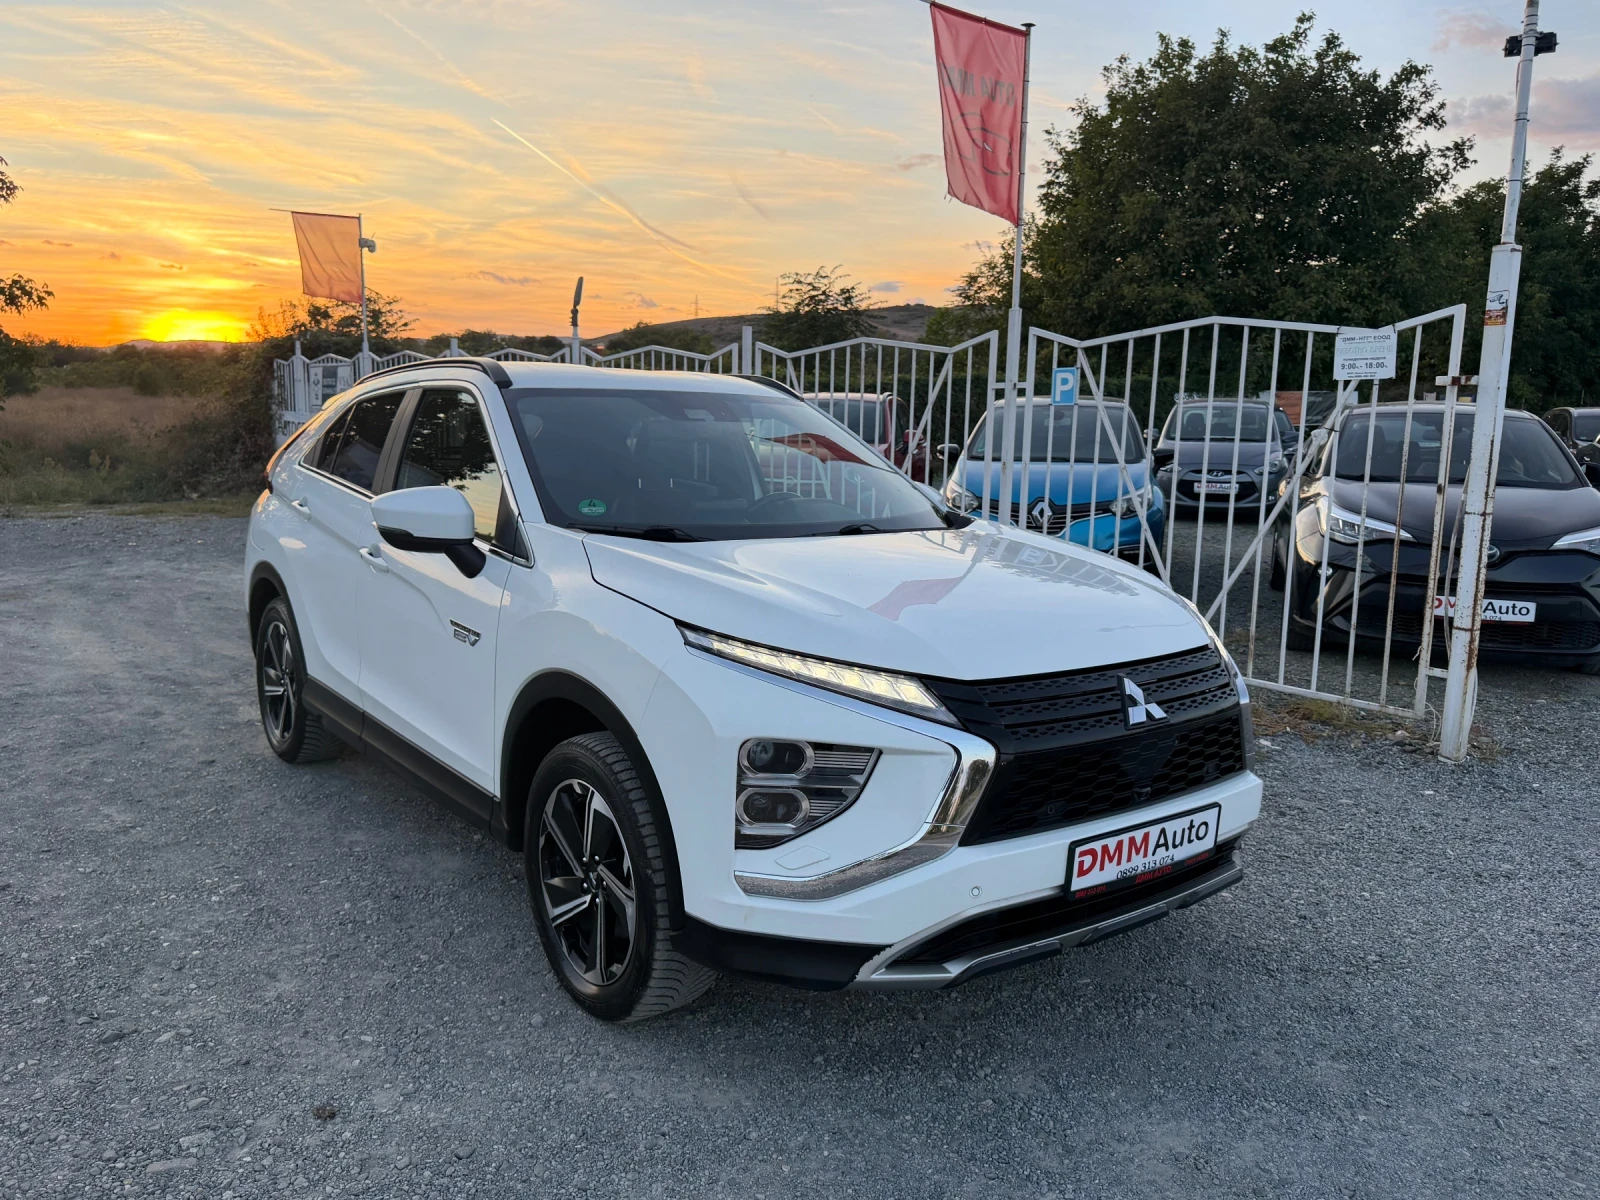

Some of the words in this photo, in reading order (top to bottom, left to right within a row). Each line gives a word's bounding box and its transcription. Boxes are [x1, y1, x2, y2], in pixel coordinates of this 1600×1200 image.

[1055, 372, 1074, 402] P
[588, 500, 596, 508] 4
[1482, 601, 1530, 616] Auto
[1076, 831, 1150, 878] DMM
[1151, 818, 1209, 857] Auto
[1116, 865, 1139, 880] 0899
[1140, 859, 1157, 873] 313
[1159, 853, 1175, 866] 074
